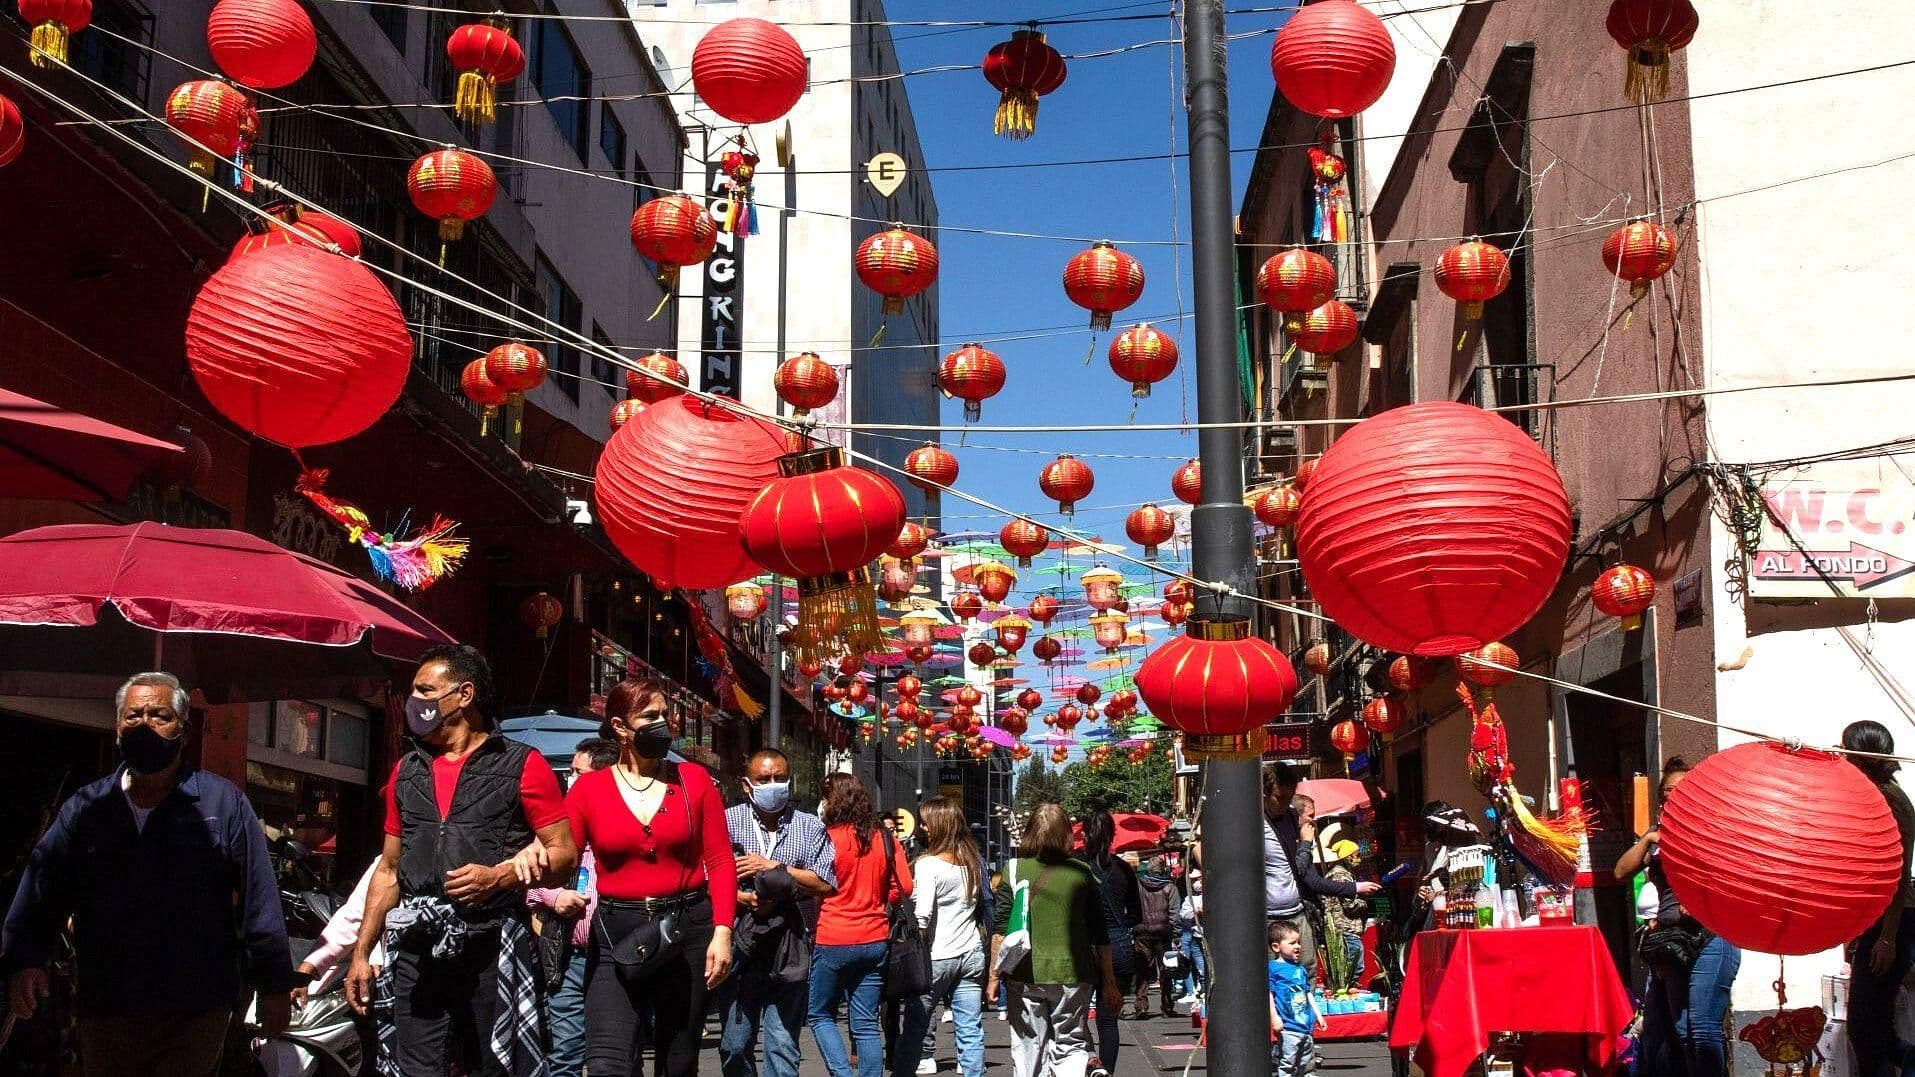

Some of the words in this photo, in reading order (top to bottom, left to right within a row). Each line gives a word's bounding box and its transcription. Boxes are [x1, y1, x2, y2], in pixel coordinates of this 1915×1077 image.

[880, 162, 894, 180] E
[707, 296, 734, 393] KIN
[1760, 489, 1905, 534] W.C.
[1761, 556, 1794, 573] AL
[1801, 556, 1888, 574] FONDO
